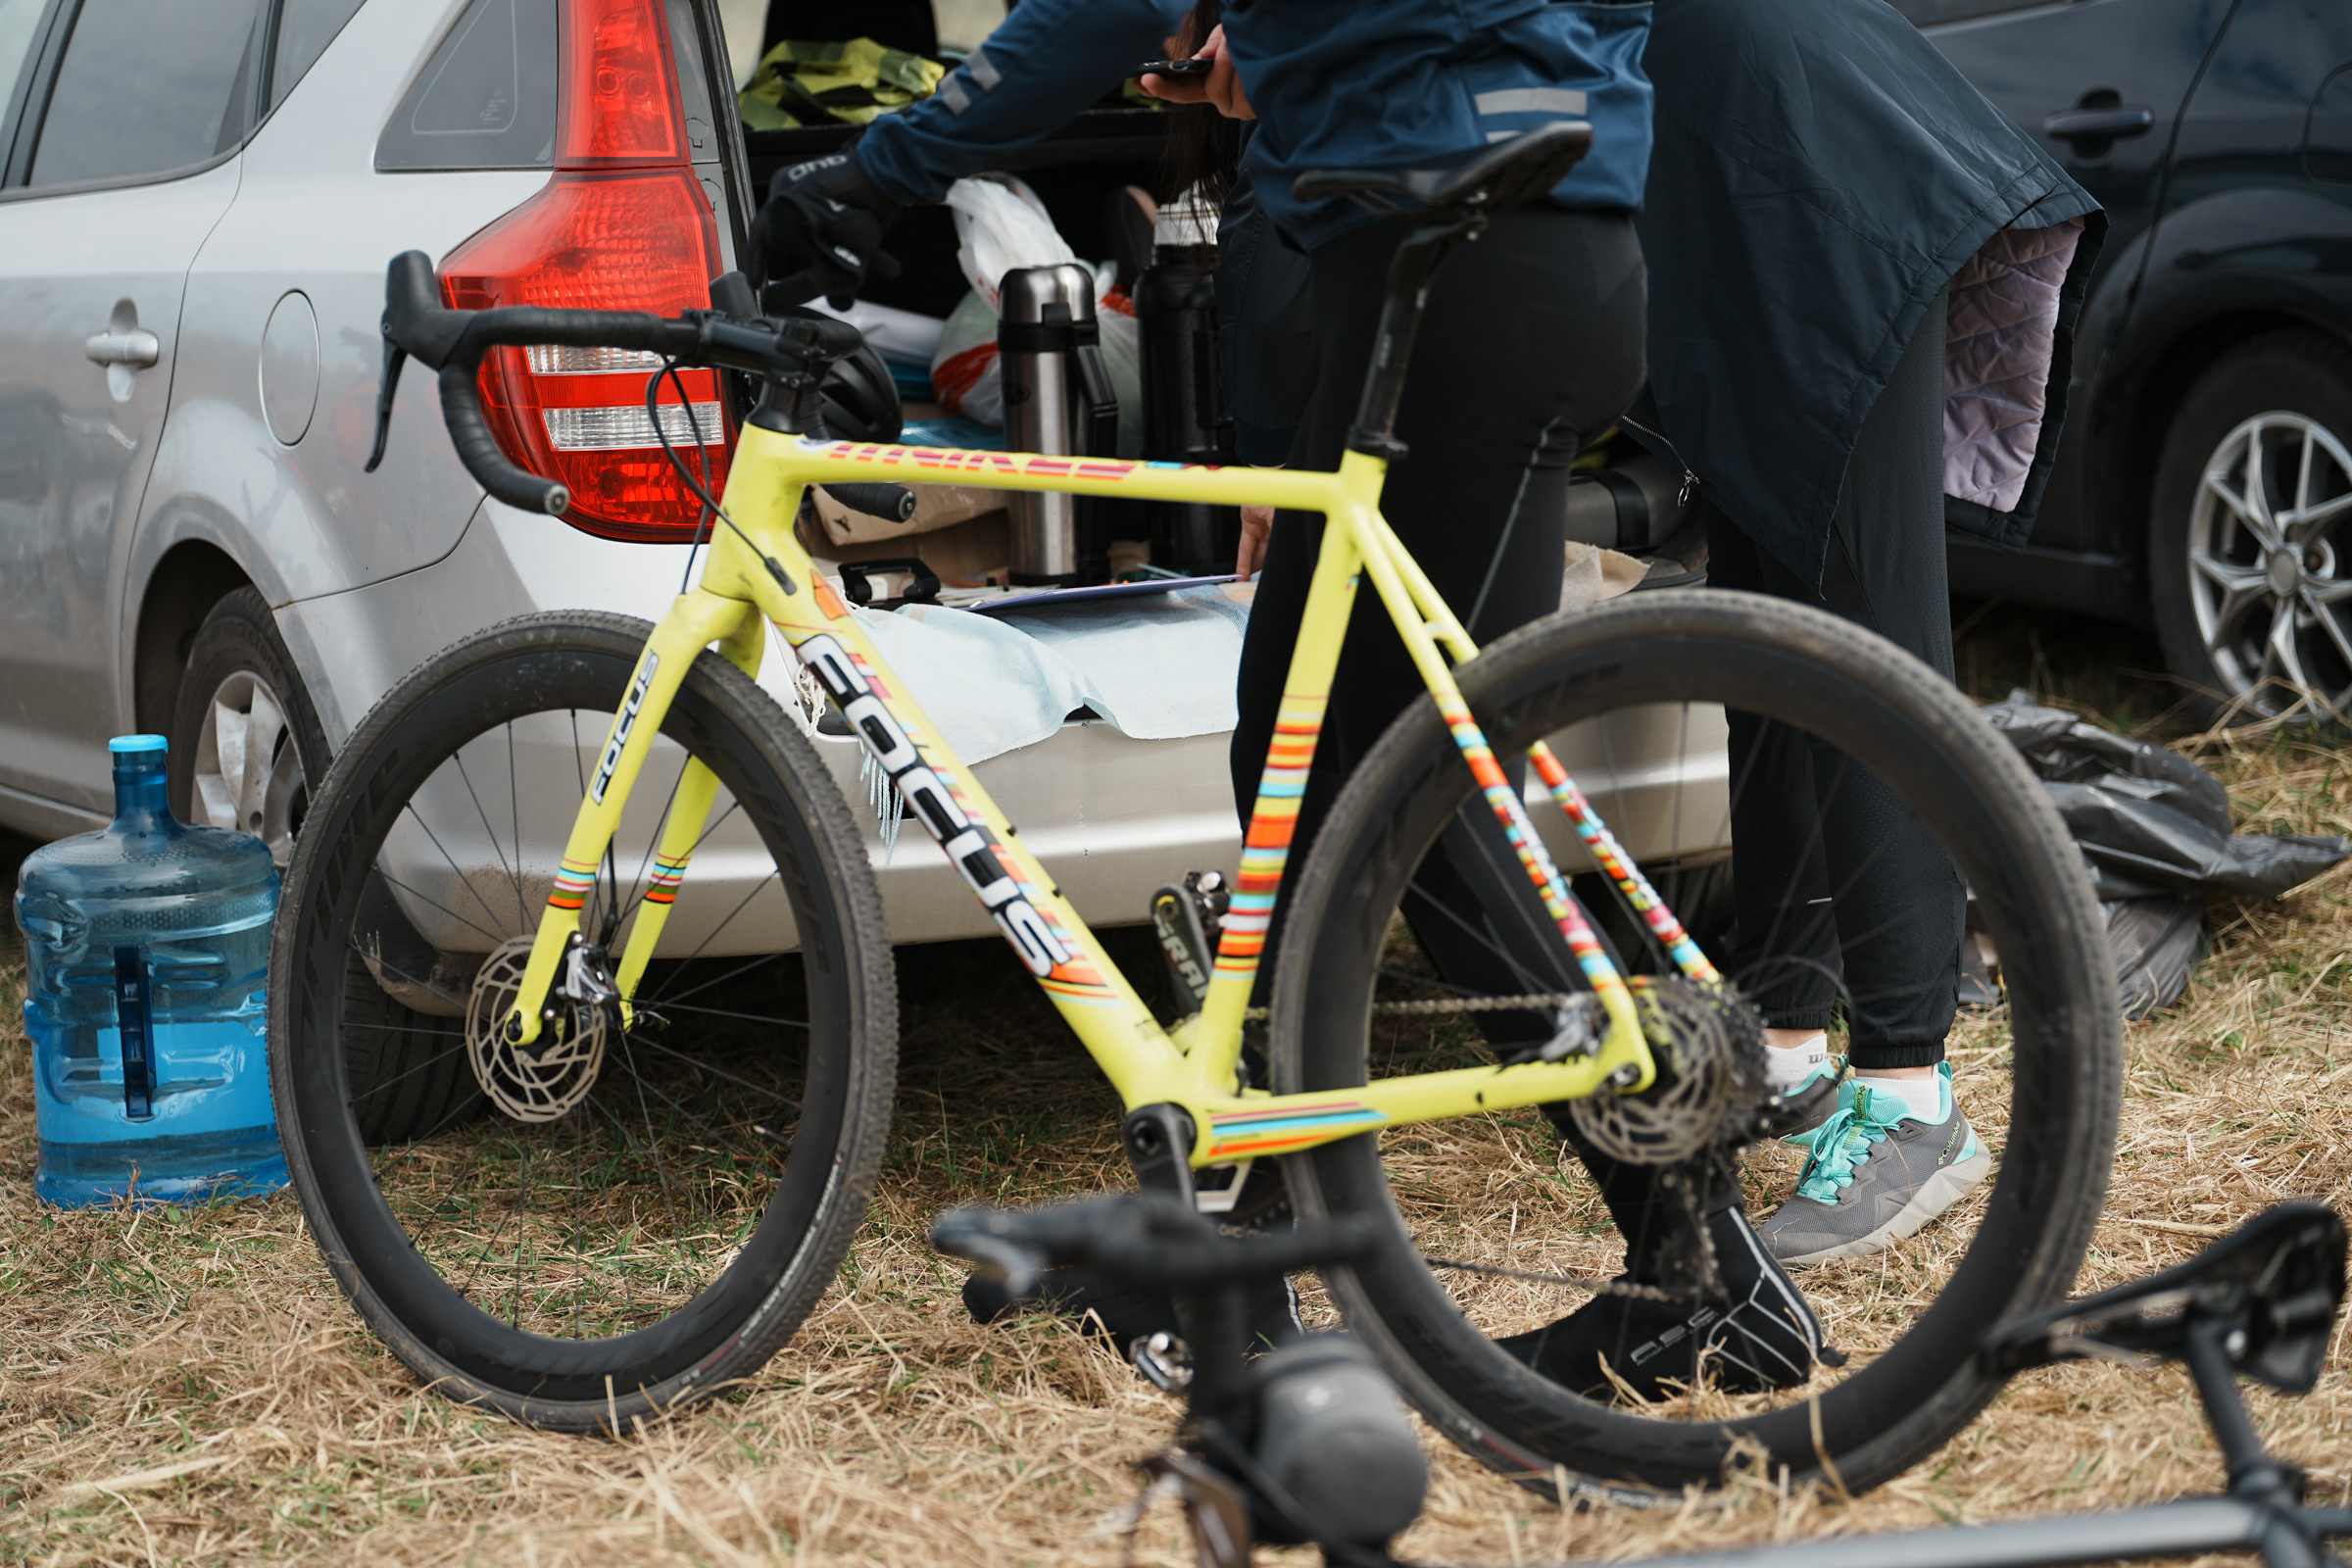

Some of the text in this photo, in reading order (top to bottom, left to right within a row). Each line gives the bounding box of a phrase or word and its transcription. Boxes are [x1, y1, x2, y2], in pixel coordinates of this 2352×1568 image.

[589, 649, 661, 806] FOCUS
[798, 634, 1072, 978] FOCUS
[1940, 1121, 1961, 1158] Columbia
